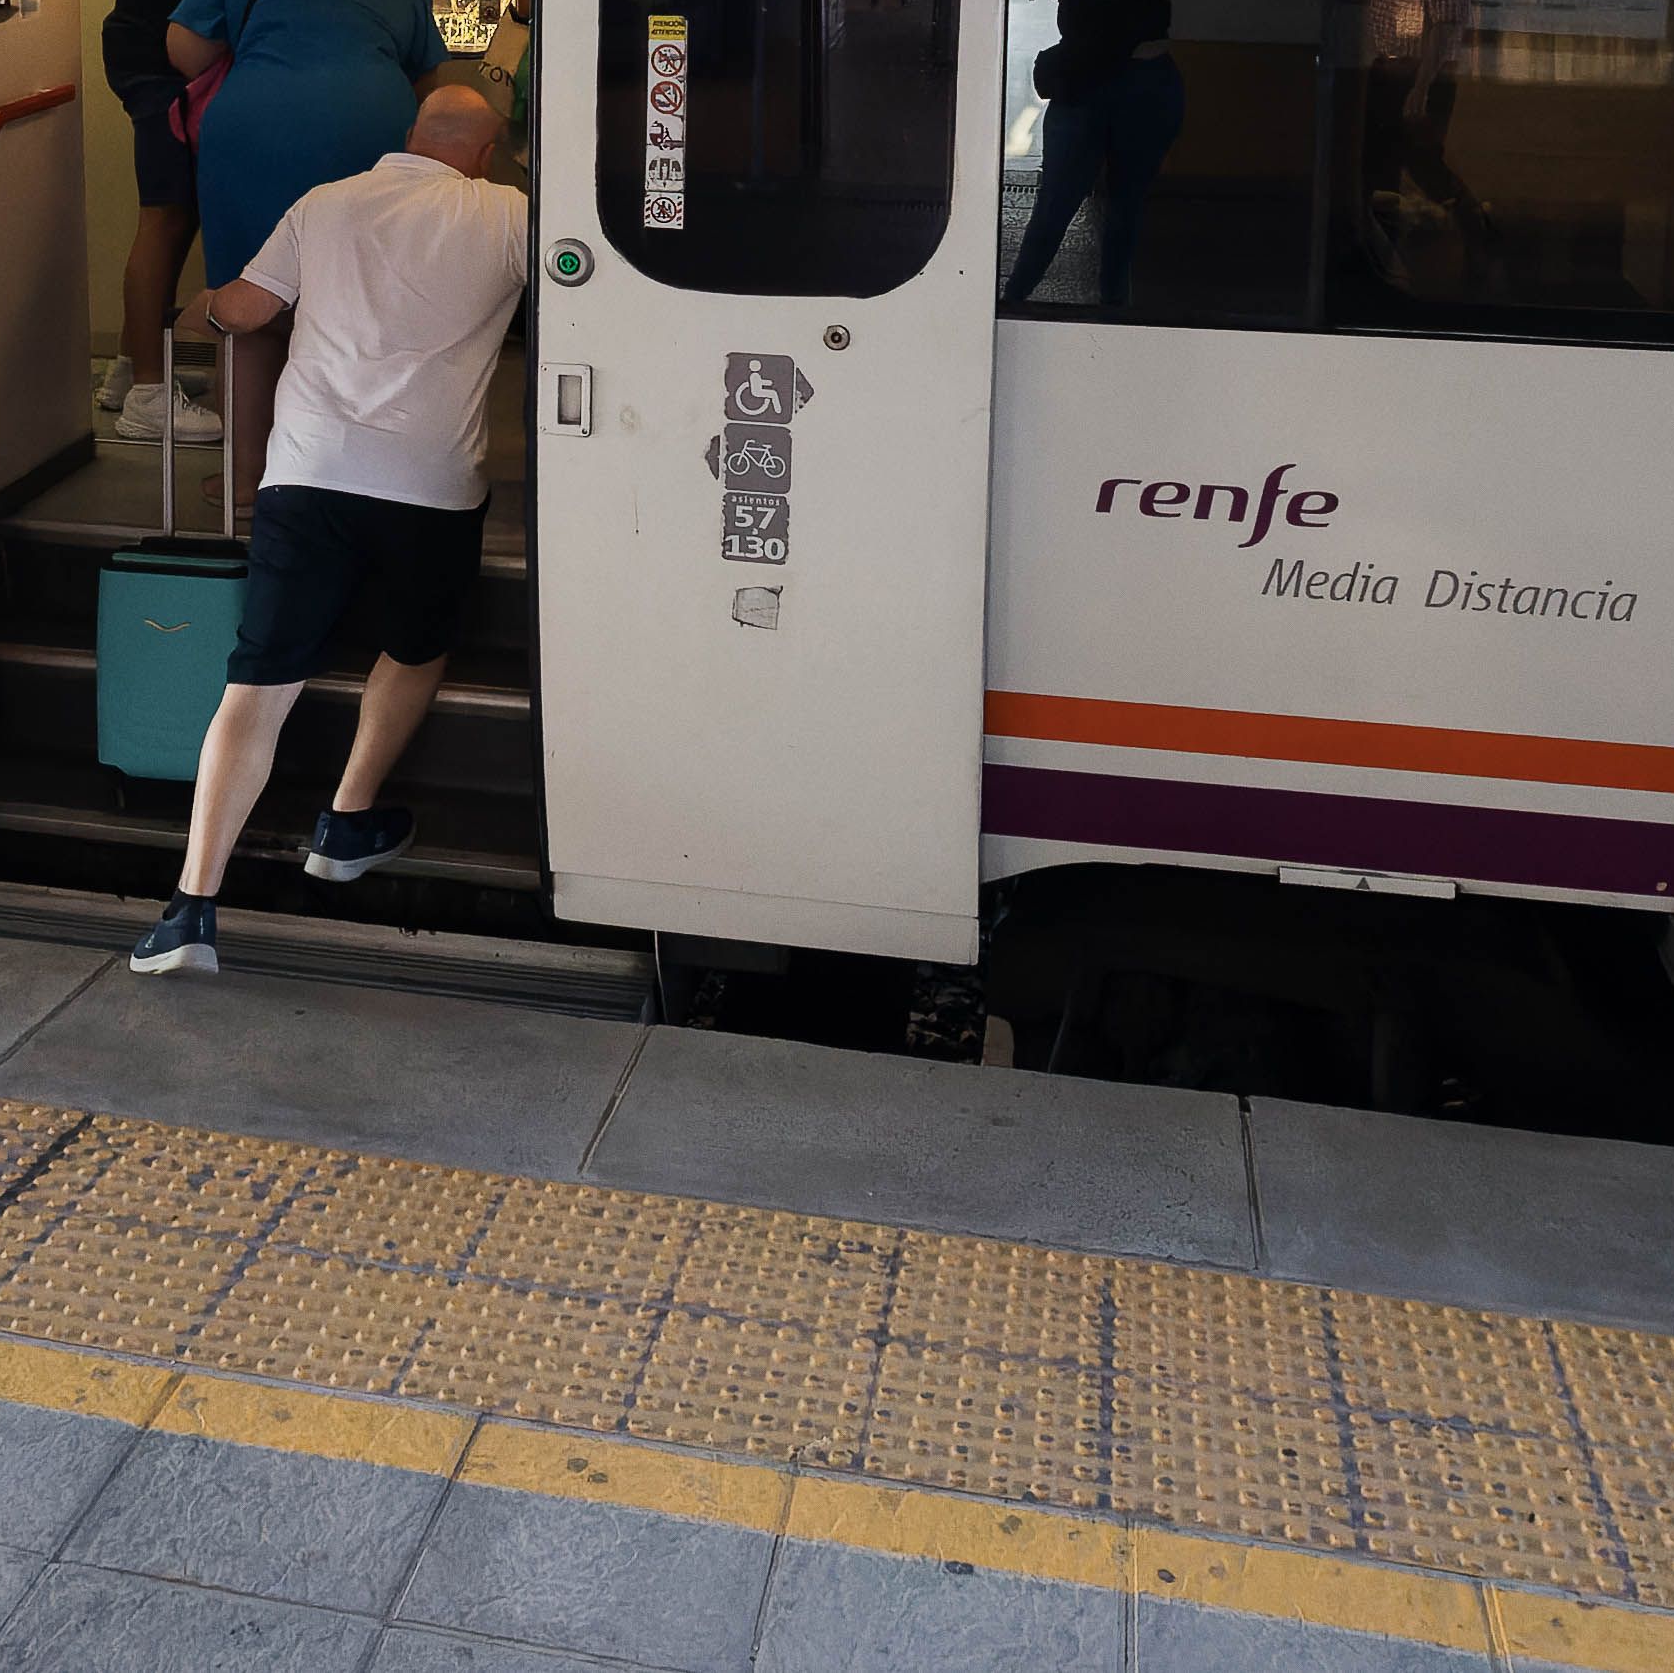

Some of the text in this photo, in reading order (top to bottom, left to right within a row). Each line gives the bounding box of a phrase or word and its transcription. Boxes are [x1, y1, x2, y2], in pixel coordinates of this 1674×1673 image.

[734, 504, 777, 529] 57
[1095, 463, 1339, 548] renfe
[724, 534, 786, 560] 130
[1261, 558, 1638, 622] Media Distancia
